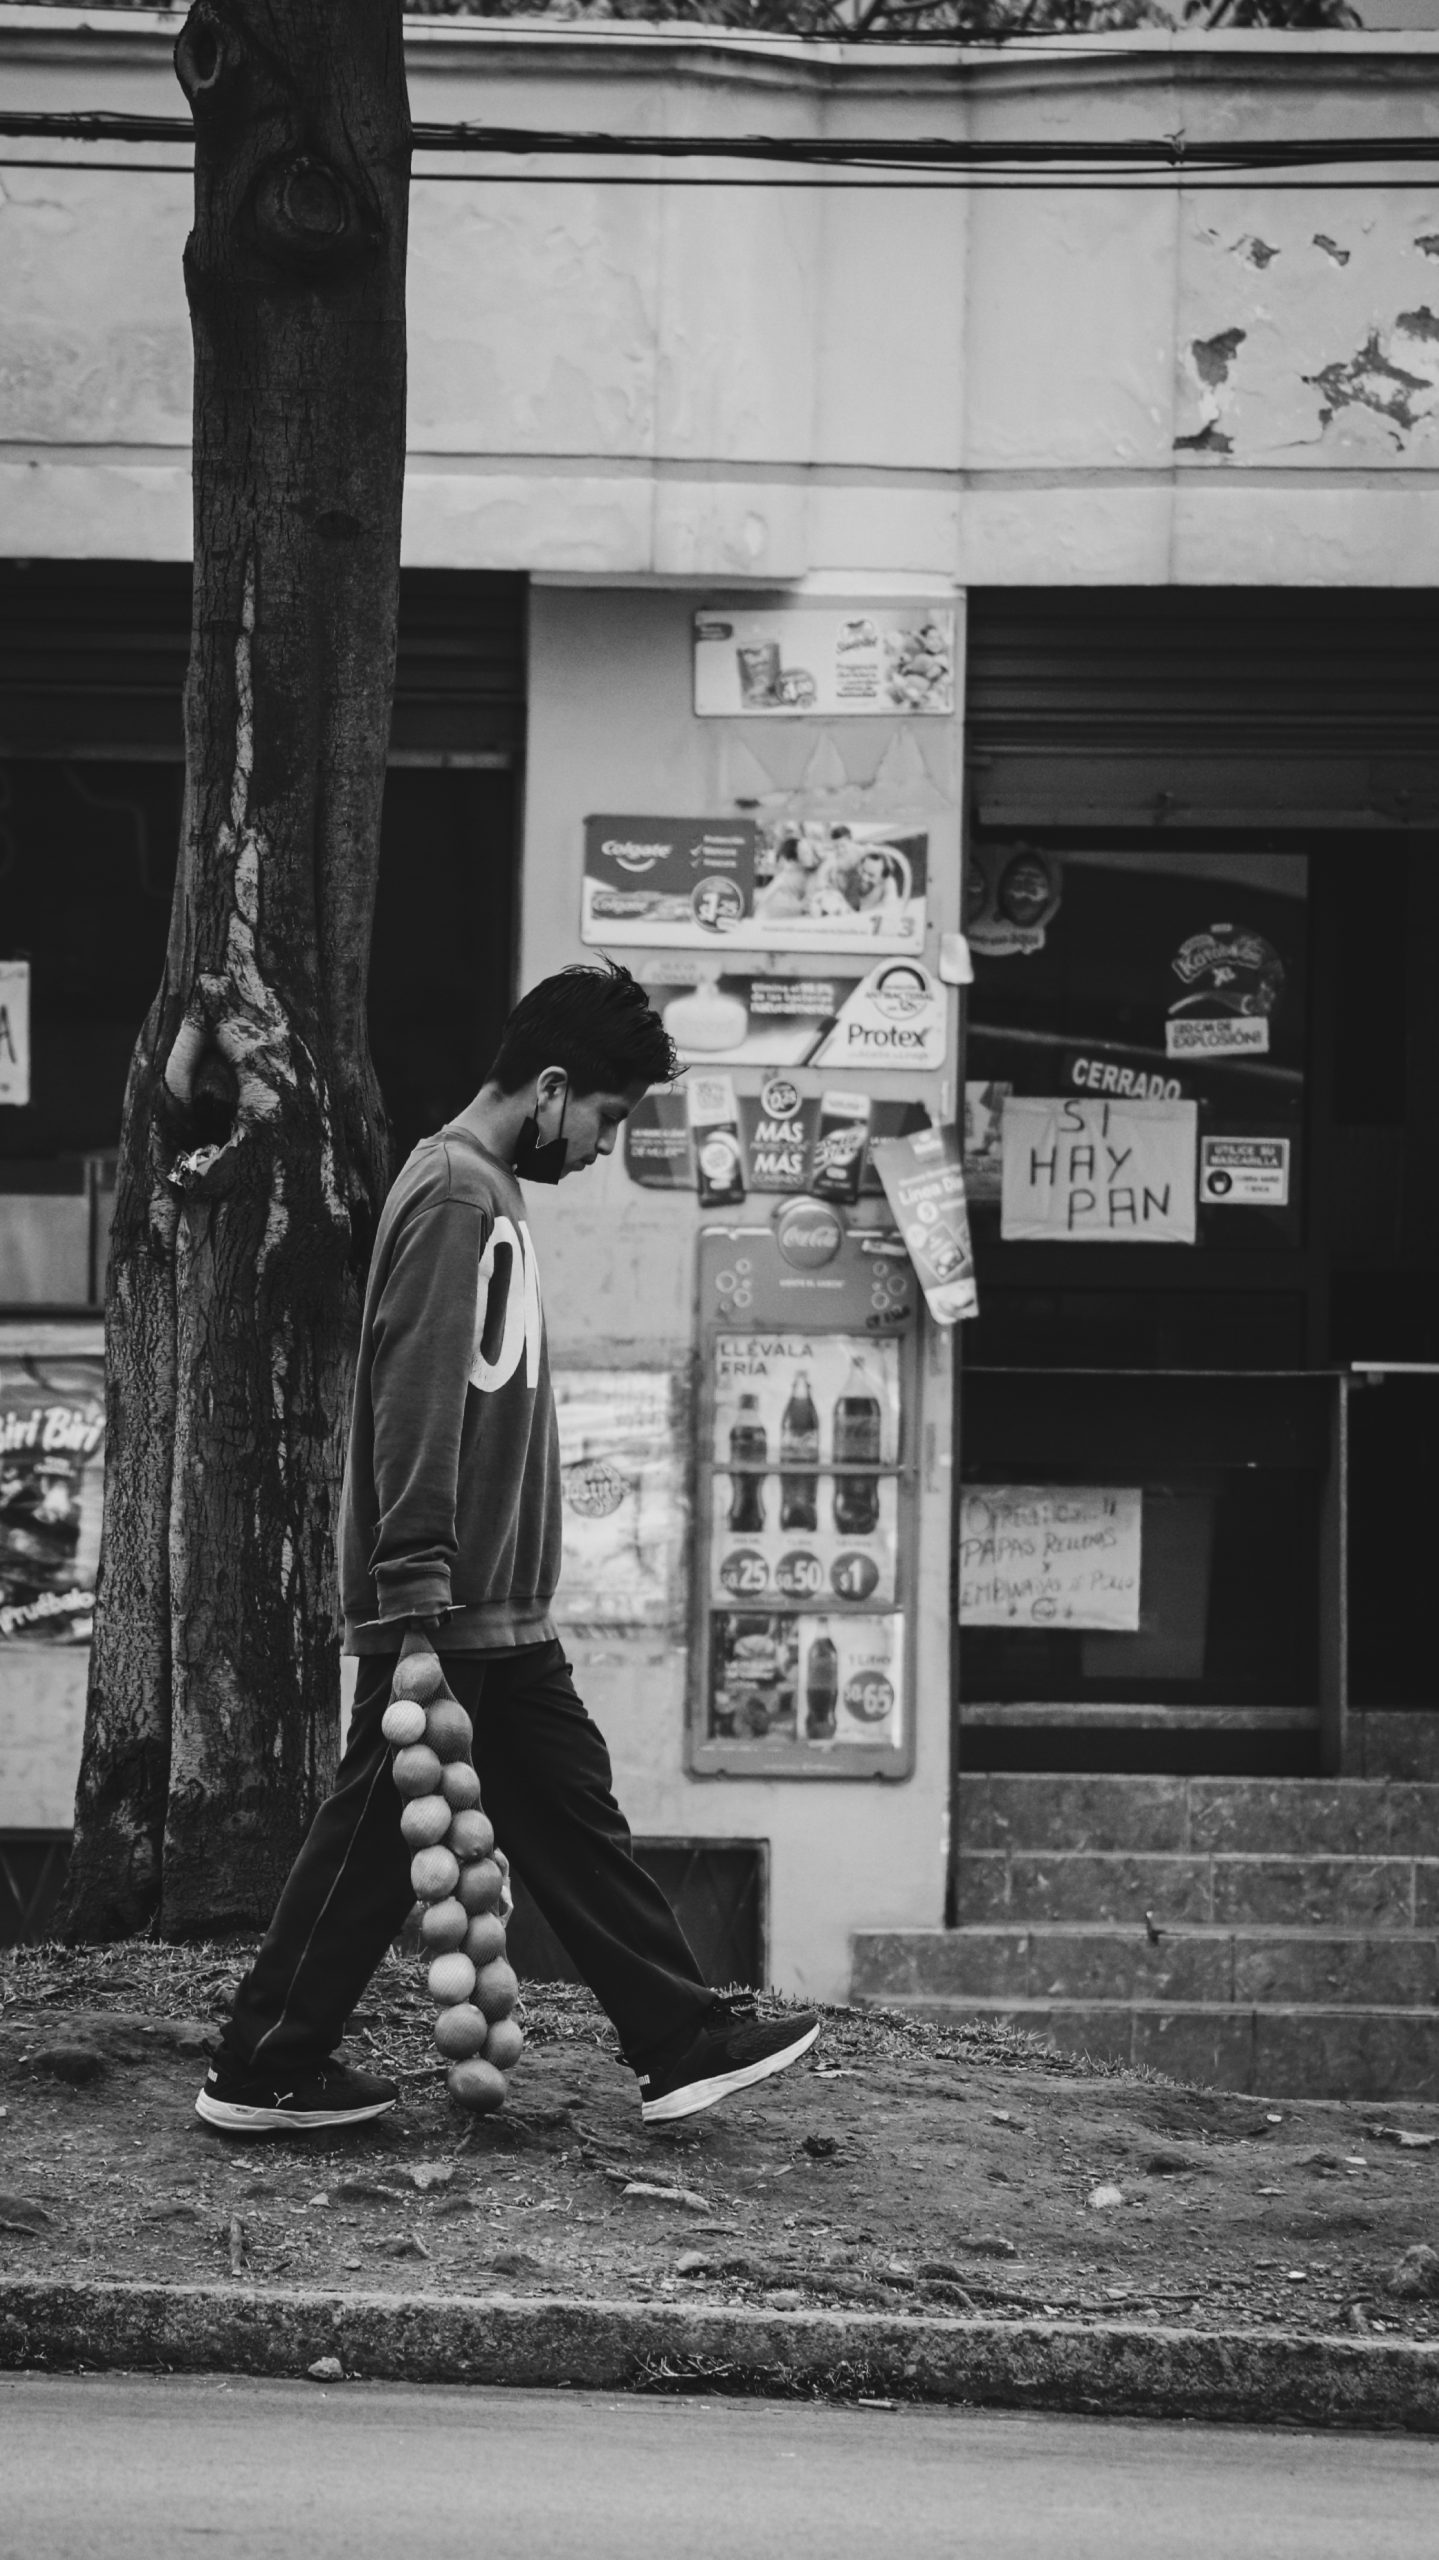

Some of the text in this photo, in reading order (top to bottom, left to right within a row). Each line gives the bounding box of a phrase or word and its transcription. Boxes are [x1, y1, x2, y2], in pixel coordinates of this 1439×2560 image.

[601, 840, 672, 860] Colgate
[848, 1023, 931, 1048] Protex
[1072, 1058, 1182, 1100] CERRADO
[1060, 1100, 1109, 1139] SI
[1030, 1145, 1132, 1186] HAY
[1067, 1183, 1170, 1231] PAN
[720, 1338, 814, 1358] LLÉVALA
[0, 1406, 106, 1454] iri Biri
